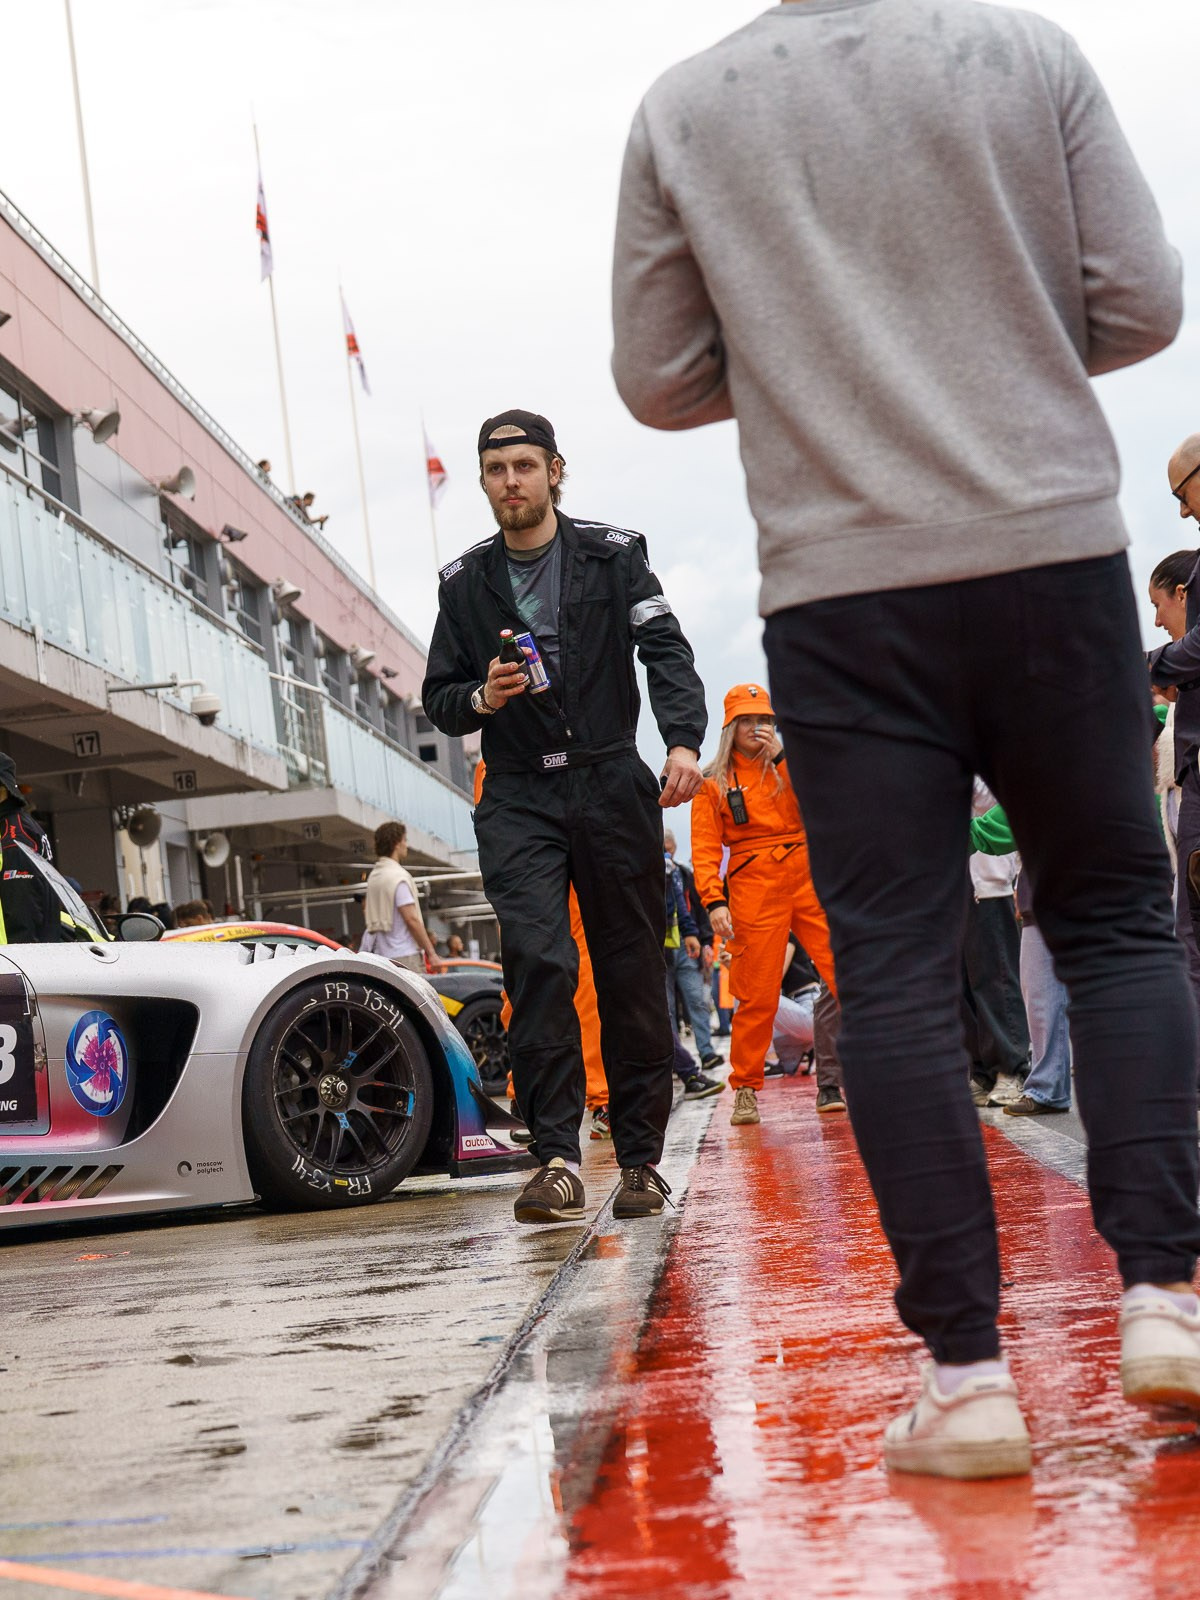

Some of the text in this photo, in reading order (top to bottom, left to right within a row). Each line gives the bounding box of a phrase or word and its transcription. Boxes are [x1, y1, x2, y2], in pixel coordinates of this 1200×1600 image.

[606, 531, 631, 544] OMP
[443, 560, 463, 579] OMP
[75, 736, 96, 755] 17
[543, 754, 568, 766] OMP
[176, 774, 194, 791] 18
[324, 982, 349, 1000] FR
[465, 1137, 494, 1148] auto.ru
